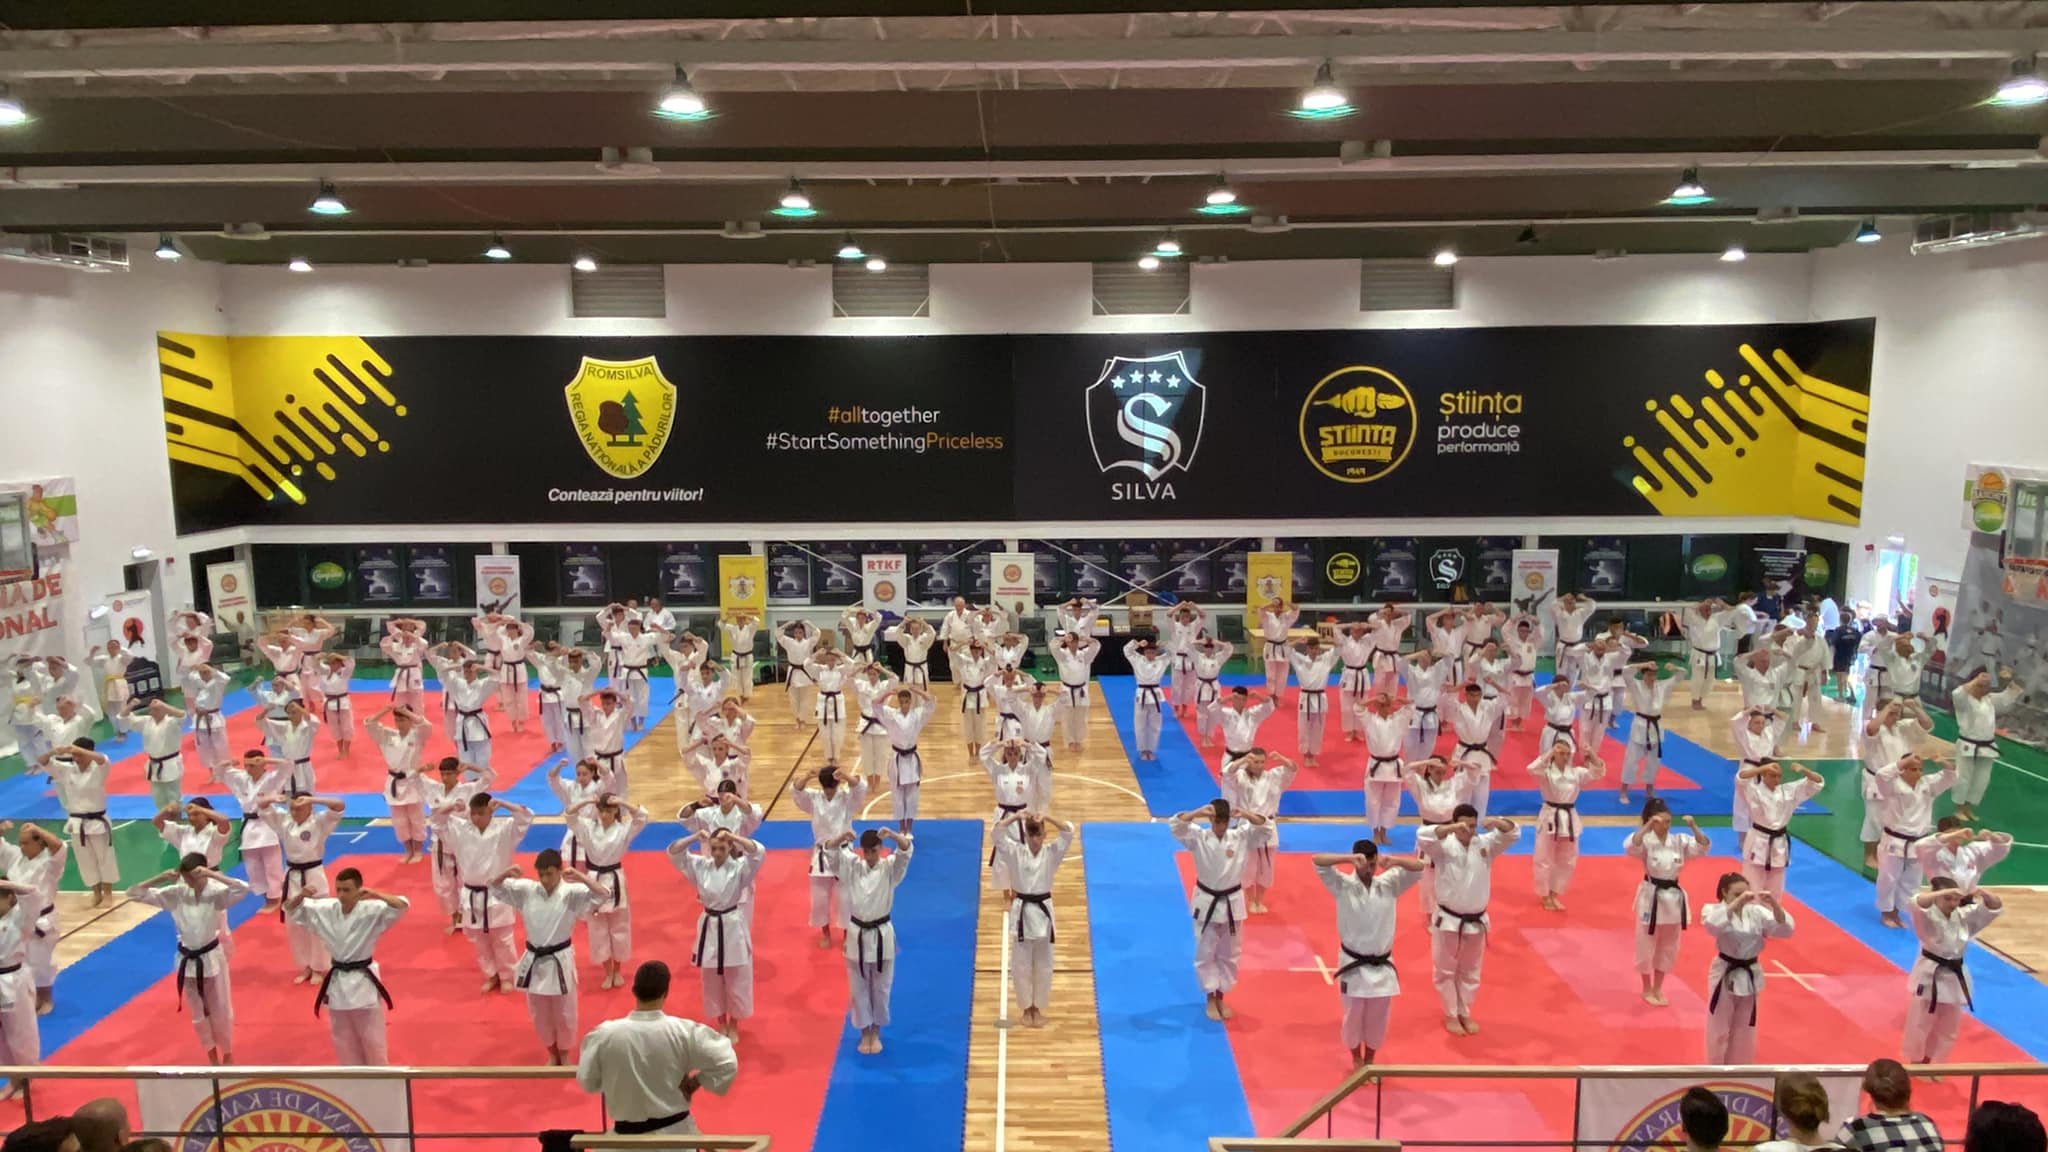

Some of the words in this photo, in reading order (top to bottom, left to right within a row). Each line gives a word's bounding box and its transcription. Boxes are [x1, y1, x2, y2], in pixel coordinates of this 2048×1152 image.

[587, 366, 654, 380] ROMSILVA
[570, 392, 589, 431] REGIA
[827, 405, 941, 428] #alltogether
[1437, 421, 1521, 442] produce
[765, 431, 1004, 454] #StartSomethingPriceless
[548, 487, 614, 502] Contează
[614, 489, 662, 505] pentru
[663, 487, 705, 502] viitor!
[1111, 482, 1177, 500] SILVA
[867, 560, 902, 570] RTKF
[31, 573, 63, 601] DE
